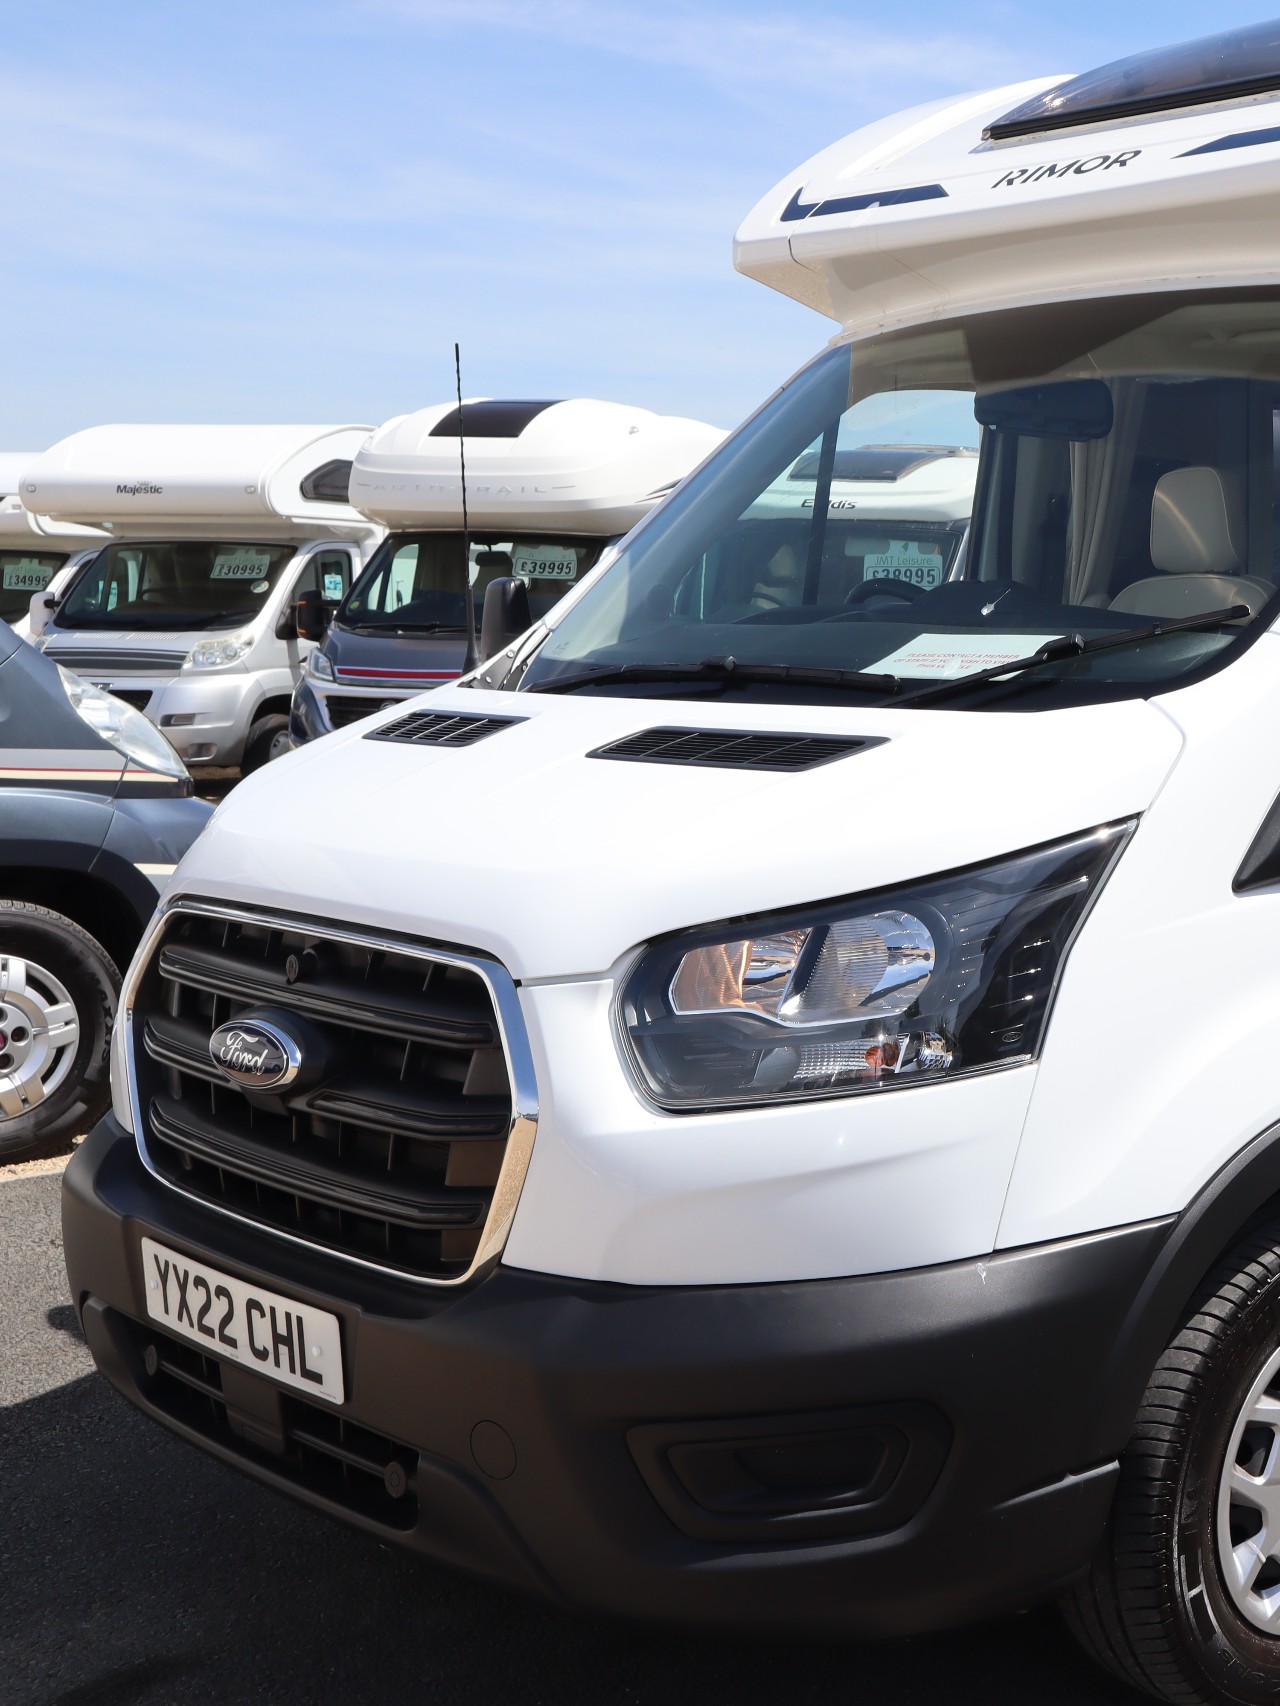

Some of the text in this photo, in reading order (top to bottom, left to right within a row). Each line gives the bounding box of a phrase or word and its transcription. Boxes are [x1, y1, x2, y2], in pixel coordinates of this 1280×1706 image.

[990, 150, 1142, 189] RIMOR
[116, 484, 163, 496] Majestic
[801, 498, 858, 509] Edis
[875, 555, 933, 566] JMT Leisure
[521, 561, 572, 575] £39995
[220, 1030, 269, 1076] Ford
[153, 1253, 324, 1386] YX22 CHL
